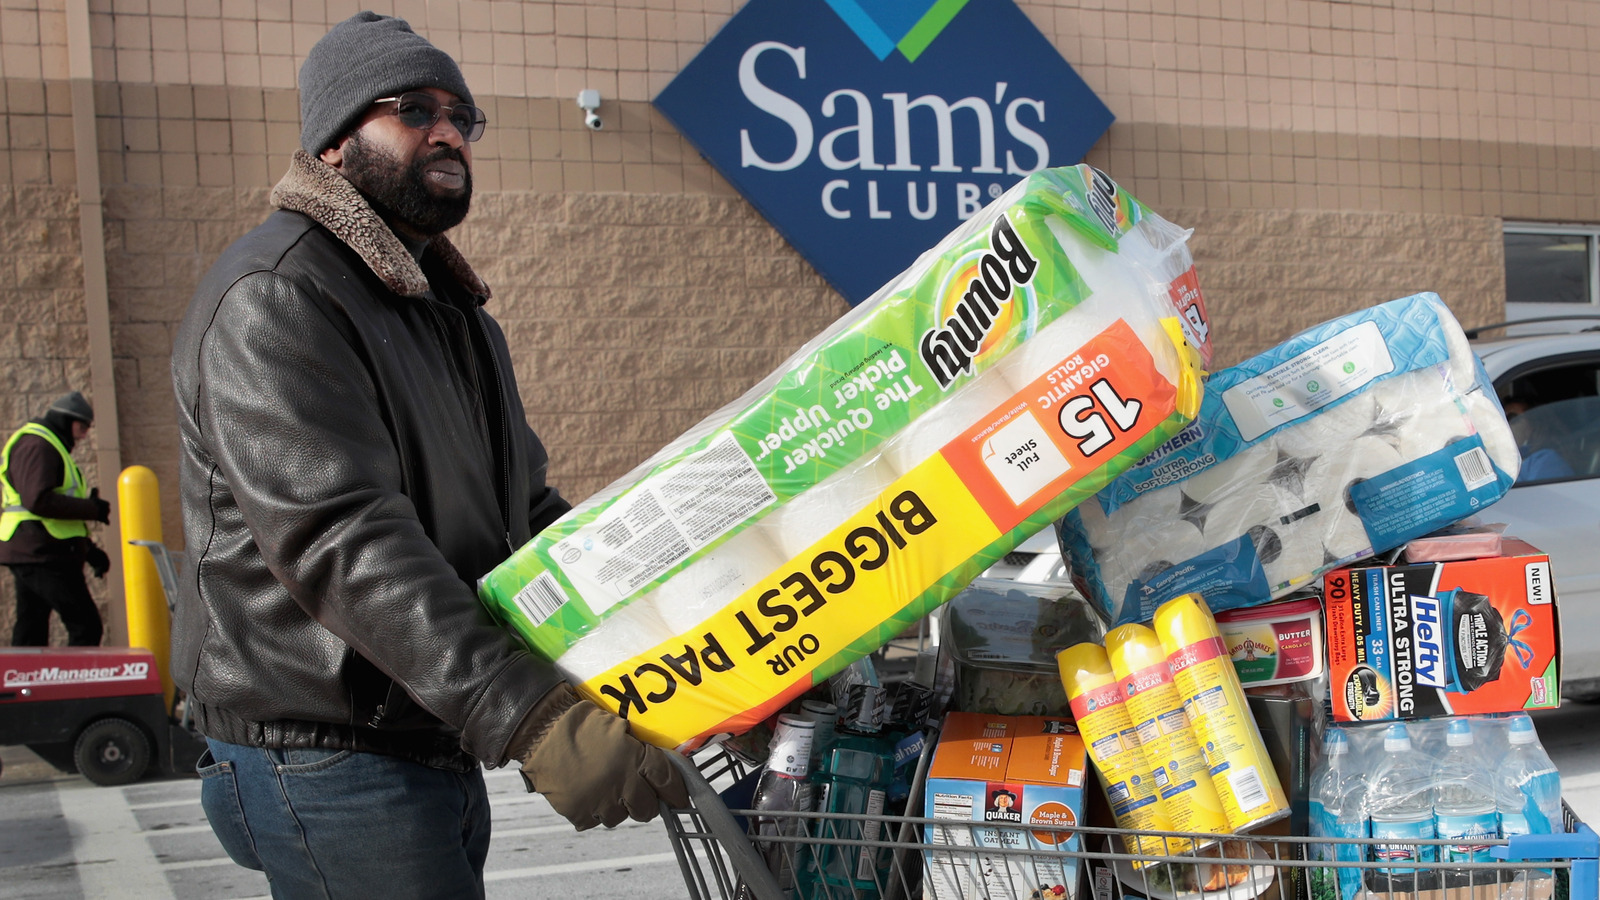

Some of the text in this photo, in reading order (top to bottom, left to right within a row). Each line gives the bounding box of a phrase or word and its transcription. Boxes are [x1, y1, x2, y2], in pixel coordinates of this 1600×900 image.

[738, 41, 1050, 176] Sam's
[921, 212, 1038, 389] Bounty
[863, 347, 883, 364] leading
[826, 348, 908, 412] Picker
[842, 360, 866, 378] ordinary
[1047, 354, 1084, 384] ROLLS
[828, 374, 845, 389] brand
[870, 370, 923, 415] The
[1038, 354, 1110, 409] GIGANTIC
[1058, 378, 1142, 457] 15
[775, 401, 877, 479] Quicker
[1005, 439, 1037, 465] Sheet
[1019, 453, 1041, 472] Full
[1153, 458, 1187, 478] ULTRA
[735, 490, 938, 656] BIGGEST
[1156, 565, 1196, 588] Georgia-Pacific
[1530, 567, 1542, 601] NEW!
[1329, 577, 1345, 598] 90
[1390, 572, 1408, 632] ULTRA
[1351, 572, 1365, 662] HEAVY DUTY 1.05 MIL
[1278, 629, 1310, 640] BUTTER
[1411, 600, 1441, 683] Hefty
[1474, 613, 1488, 666] TRIPLE ACTION
[766, 633, 820, 676] OUR
[1228, 644, 1243, 655] LAND
[1333, 650, 1341, 665] Bags
[1371, 639, 1383, 655] 33
[4, 663, 148, 683] CartManager XD
[600, 632, 735, 720] PACK
[1174, 657, 1198, 671] CLEAN
[1134, 672, 1160, 685] LEMON
[1136, 678, 1162, 691] CLEAN
[1352, 673, 1363, 716] EXPANDABLE
[986, 811, 1021, 822] QUAKER
[1039, 811, 1060, 819] Maple
[1054, 818, 1075, 826] Sugar
